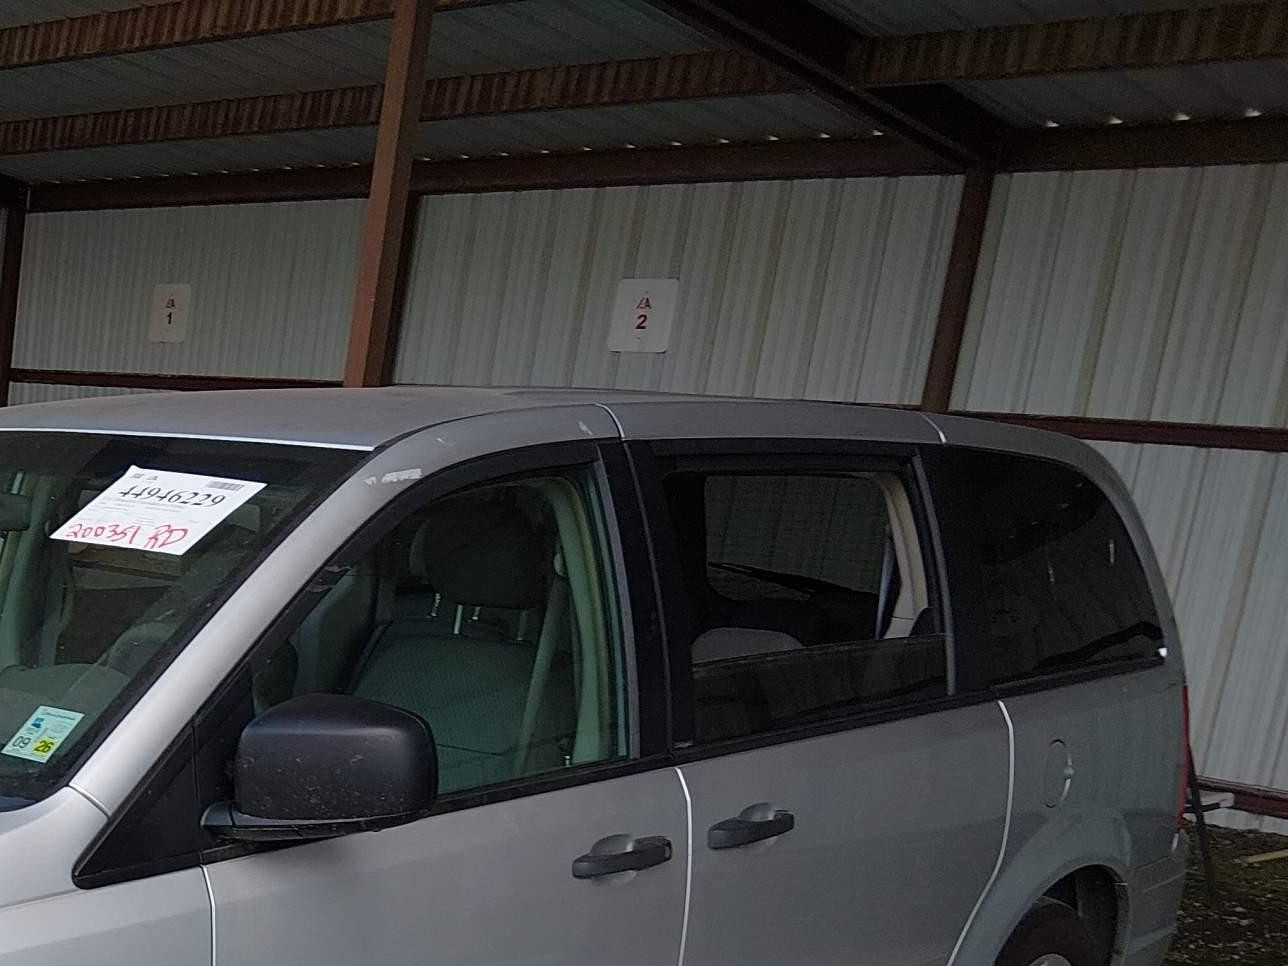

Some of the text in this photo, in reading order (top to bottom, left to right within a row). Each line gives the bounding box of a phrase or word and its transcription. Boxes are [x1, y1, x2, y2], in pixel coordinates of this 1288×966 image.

[166, 311, 173, 325] 1
[635, 314, 648, 330] 2
[119, 485, 226, 508] 44946229
[12, 736, 32, 749] 09
[34, 740, 54, 754] 26
